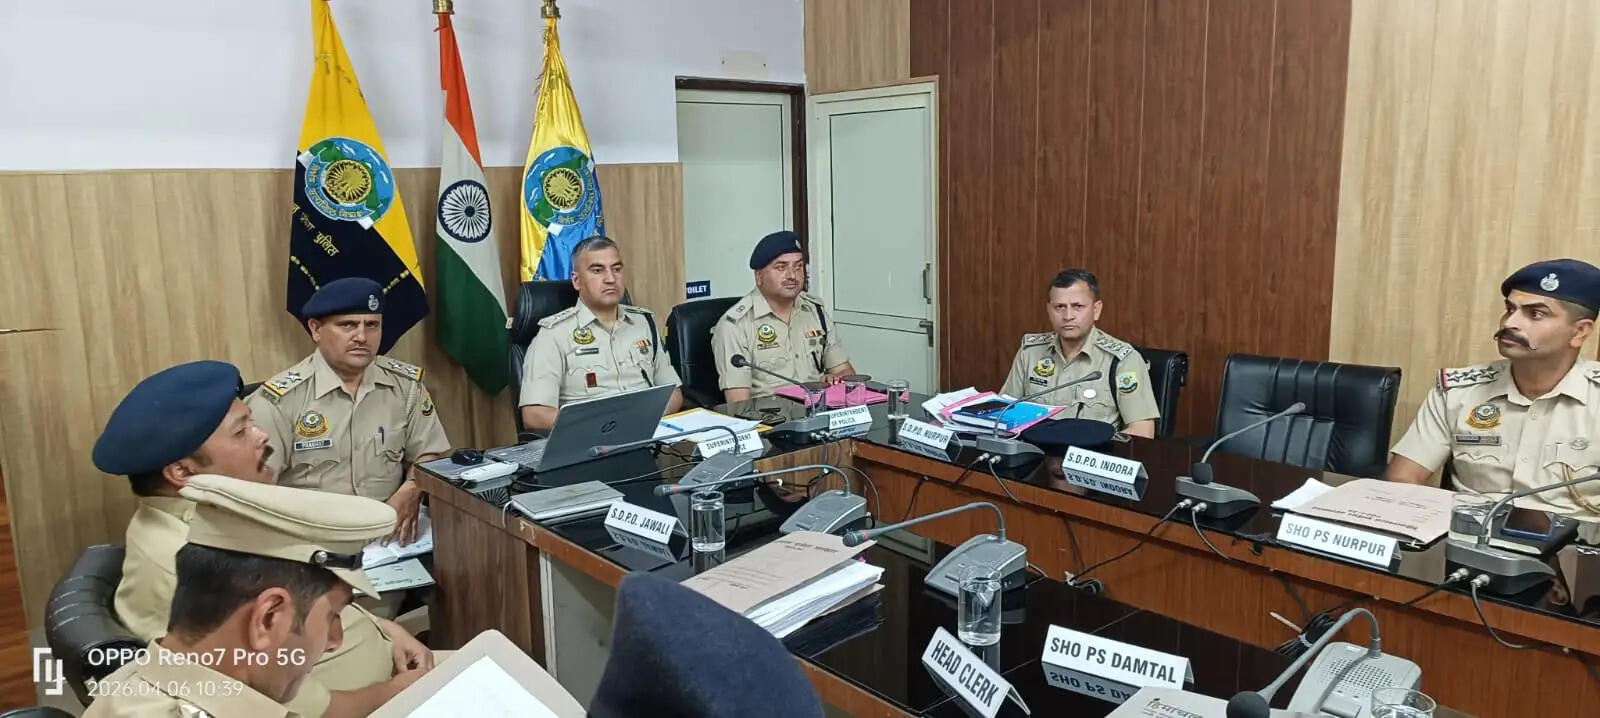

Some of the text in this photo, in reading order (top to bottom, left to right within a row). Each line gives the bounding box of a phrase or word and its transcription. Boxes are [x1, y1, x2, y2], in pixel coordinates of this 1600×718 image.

[313, 231, 340, 257] पुलिस
[687, 285, 707, 294] OILET
[831, 406, 867, 419] UPERINTENDENT
[706, 433, 752, 450] SUPERINTEDENT
[924, 429, 949, 444] NURPUR
[1067, 452, 1134, 477] S.D.P.O. INDORA
[611, 507, 670, 535] S.D.P.O. JAWALI
[1286, 523, 1386, 557] SHO PS NURPUR
[1050, 637, 1177, 683] SHO PS DAMTAL
[931, 639, 999, 708] HEAD CLERK
